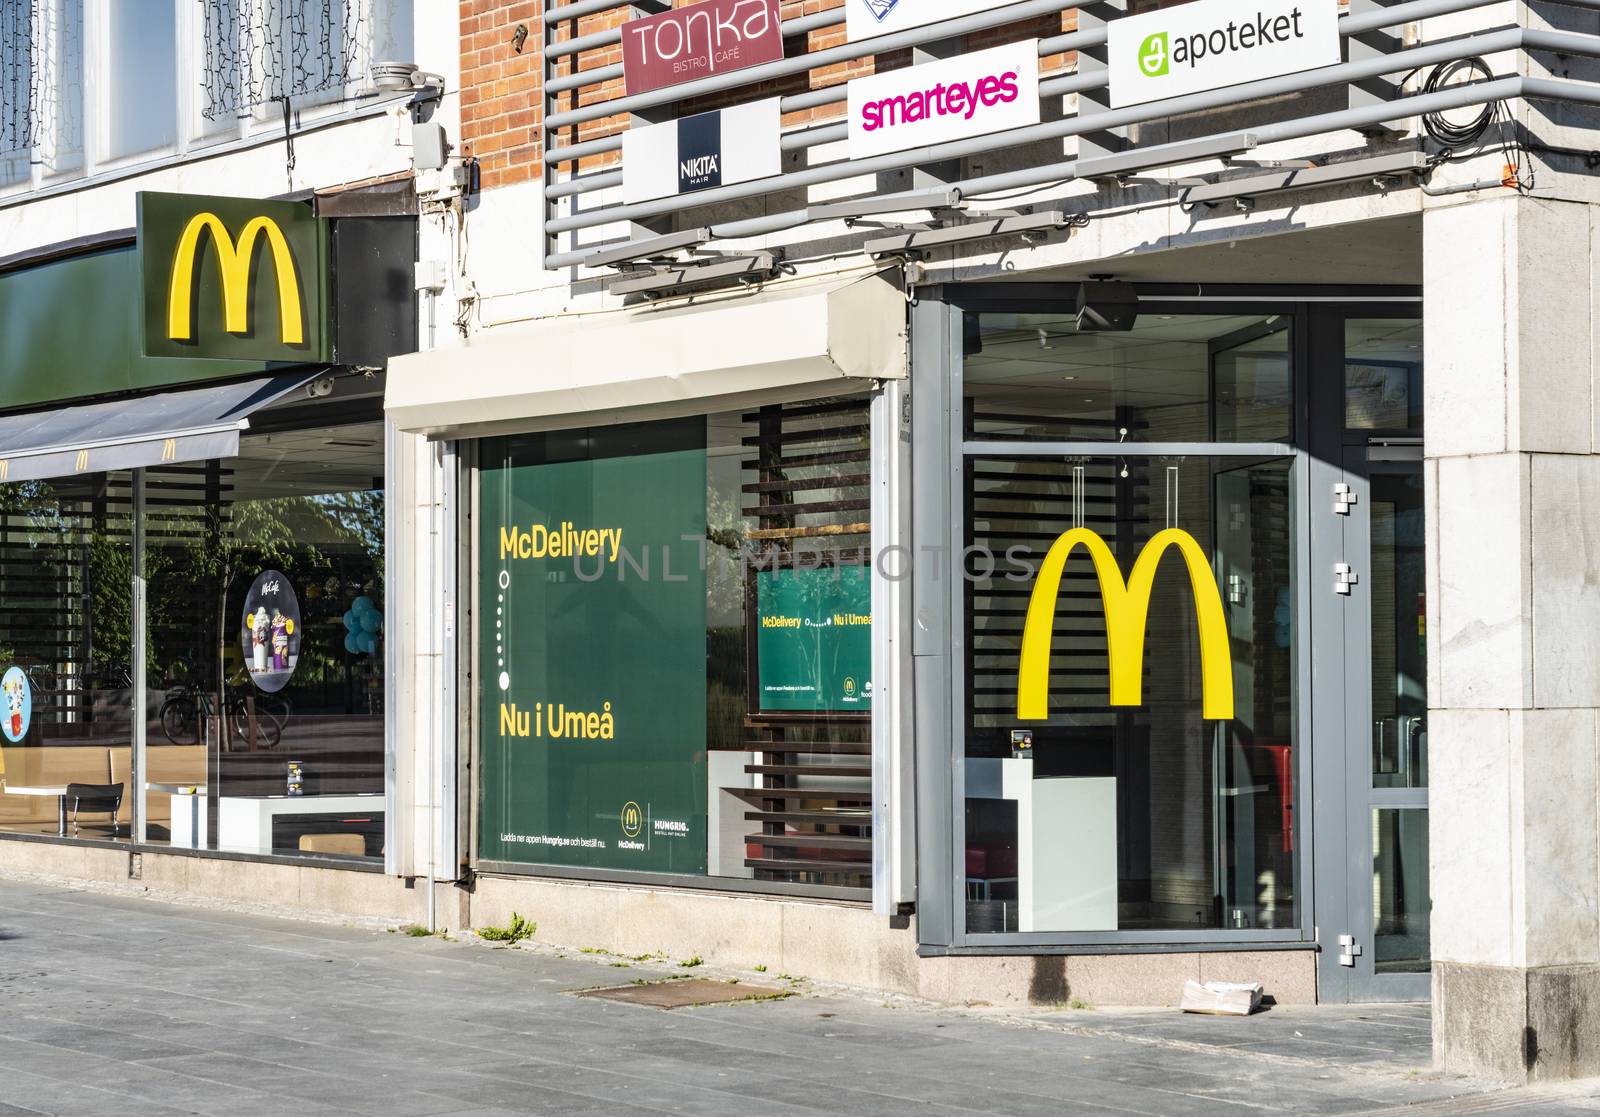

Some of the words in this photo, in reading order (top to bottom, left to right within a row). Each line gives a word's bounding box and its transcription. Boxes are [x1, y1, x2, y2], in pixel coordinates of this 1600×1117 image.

[1173, 7, 1304, 68] apoteket
[673, 56, 707, 73] BISTRO
[715, 46, 740, 63] CAFÉ
[862, 71, 1019, 131] smarteyes
[690, 176, 709, 184] HAIR
[500, 521, 622, 562] McDelivery
[762, 615, 801, 629] McDelivery
[834, 613, 844, 626] Nu
[845, 613, 849, 625] i
[500, 703, 530, 737] Nu
[535, 702, 541, 737] i
[547, 701, 614, 739] Umeå
[500, 832, 516, 842] Ladda
[516, 834, 525, 842] ner
[525, 834, 541, 844] appen
[541, 835, 570, 846] Hungrig.se
[570, 837, 580, 846] och
[580, 837, 597, 848] beställ
